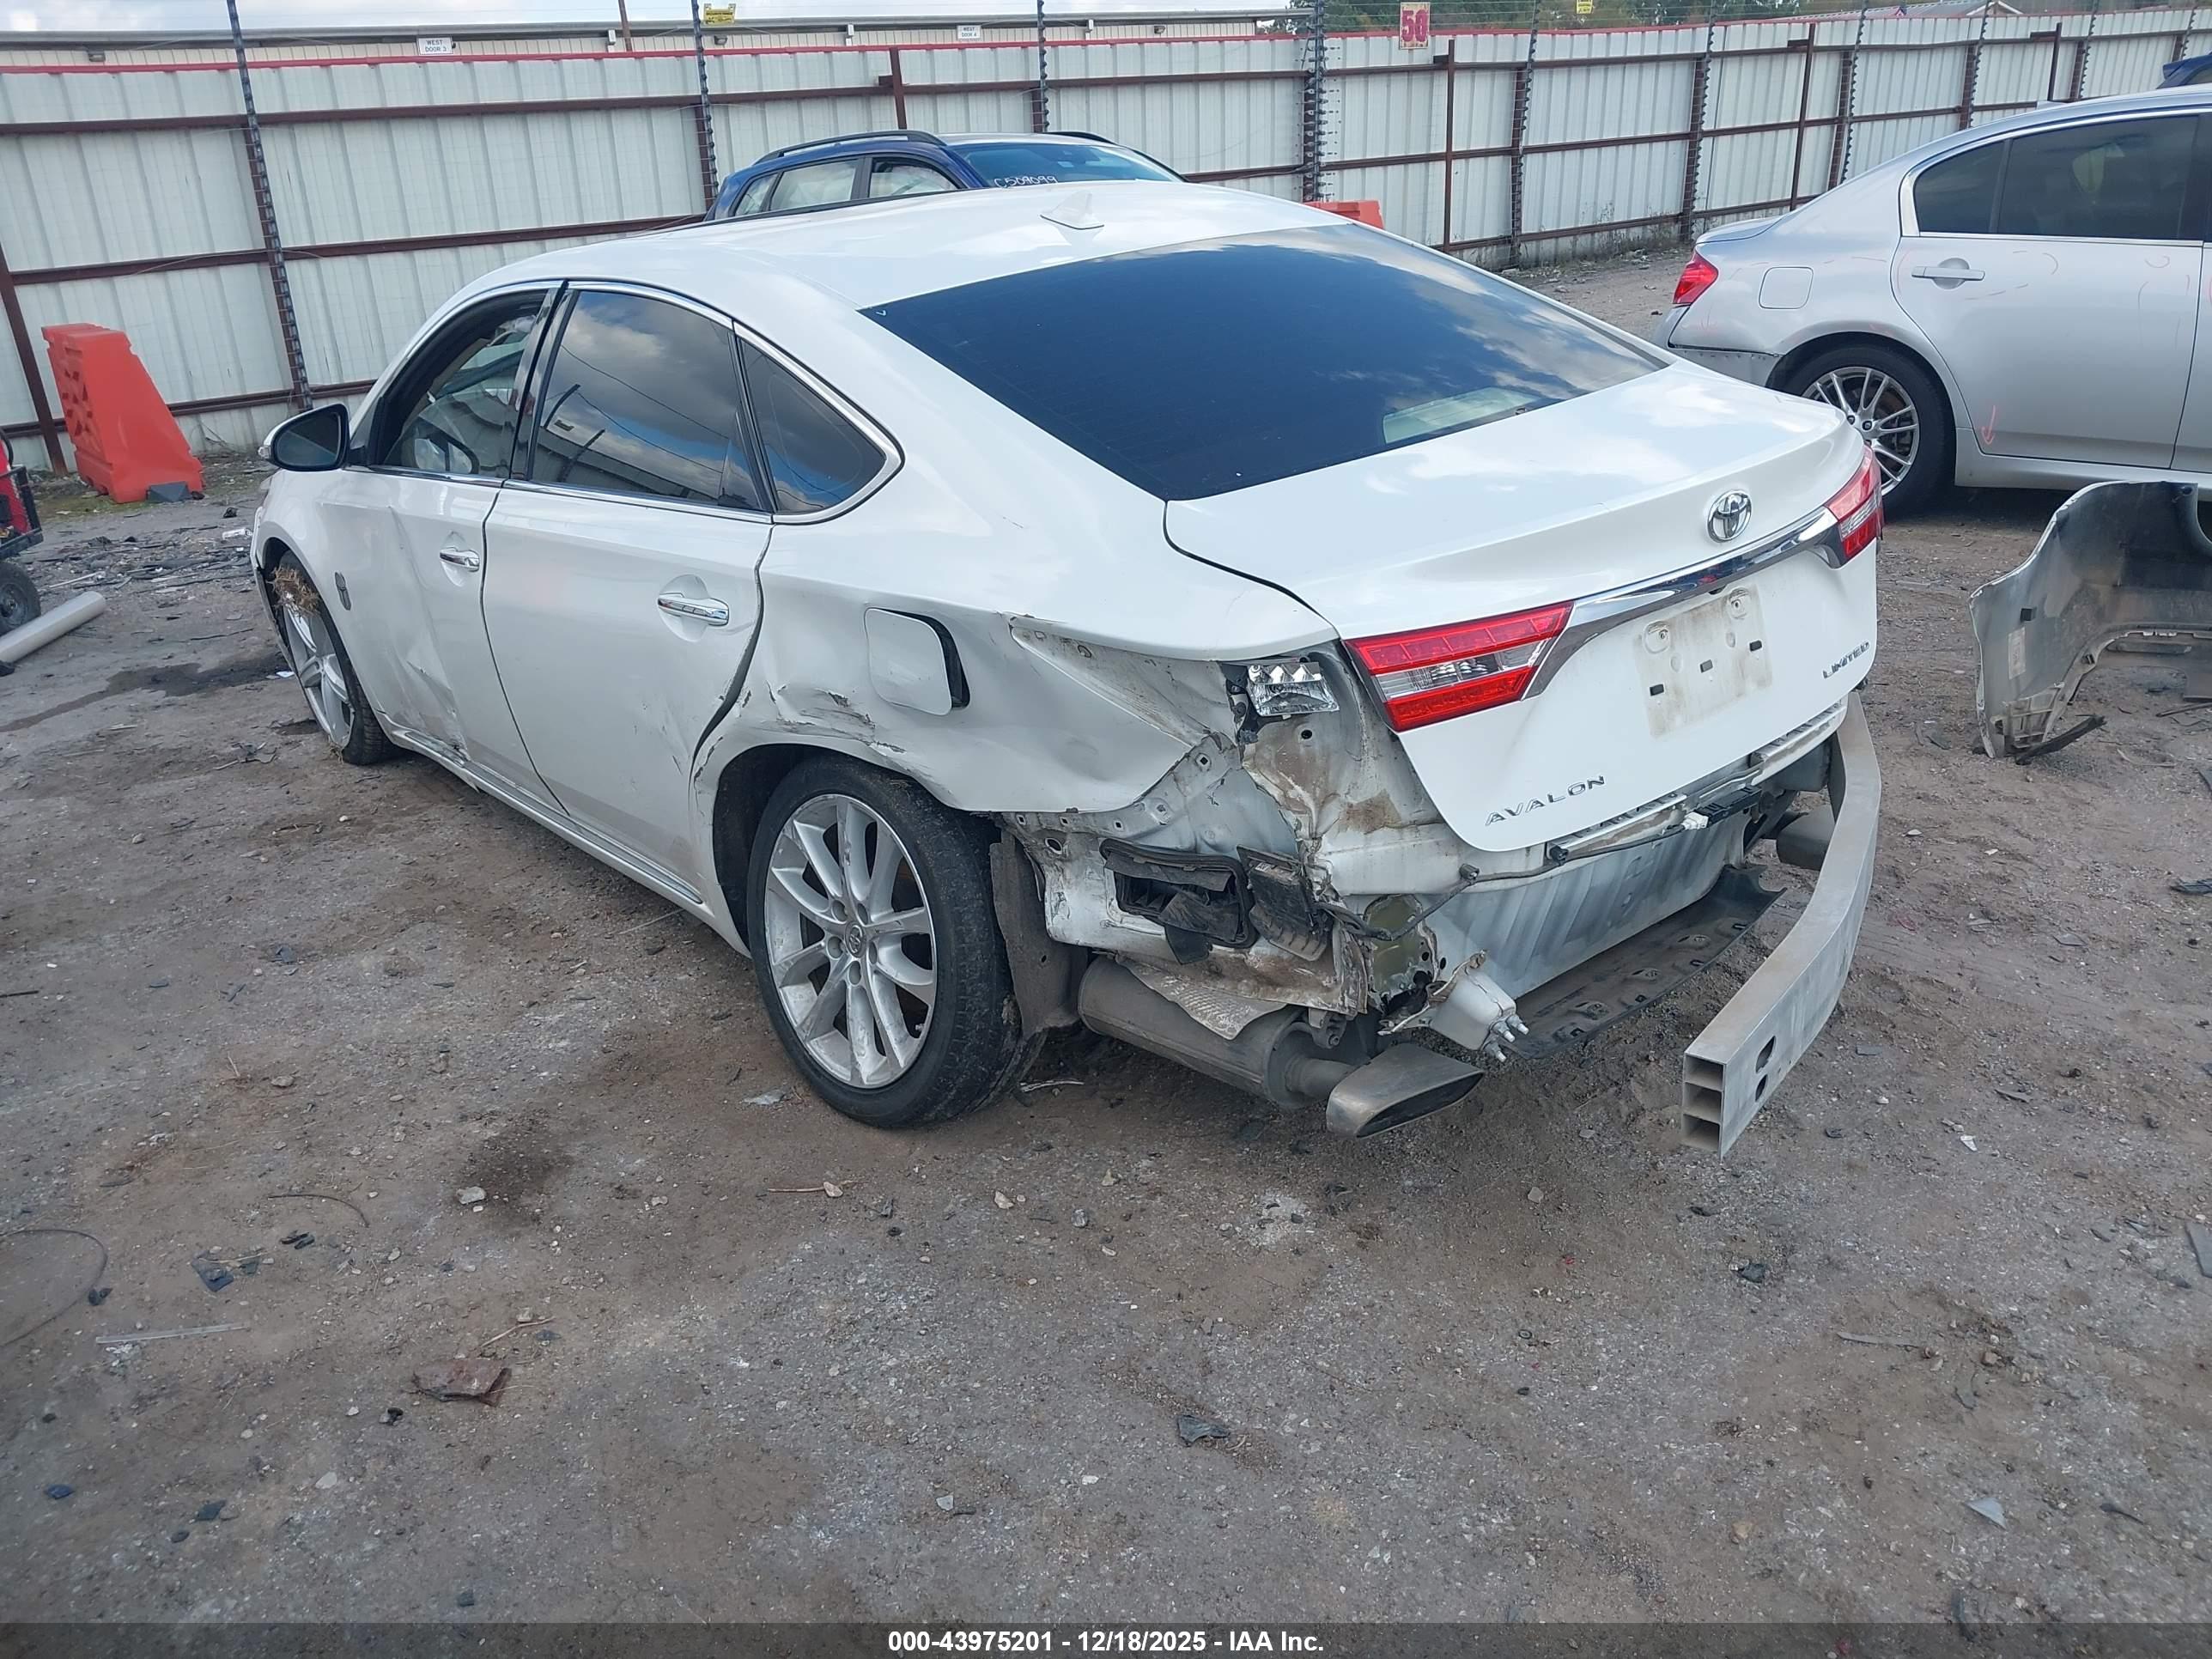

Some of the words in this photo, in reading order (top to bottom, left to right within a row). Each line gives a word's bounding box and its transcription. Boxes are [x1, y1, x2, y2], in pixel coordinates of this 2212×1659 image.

[1401, 9, 1428, 42] 50
[1822, 641, 1870, 679] LIMITED
[1485, 775, 1605, 826] AVALON
